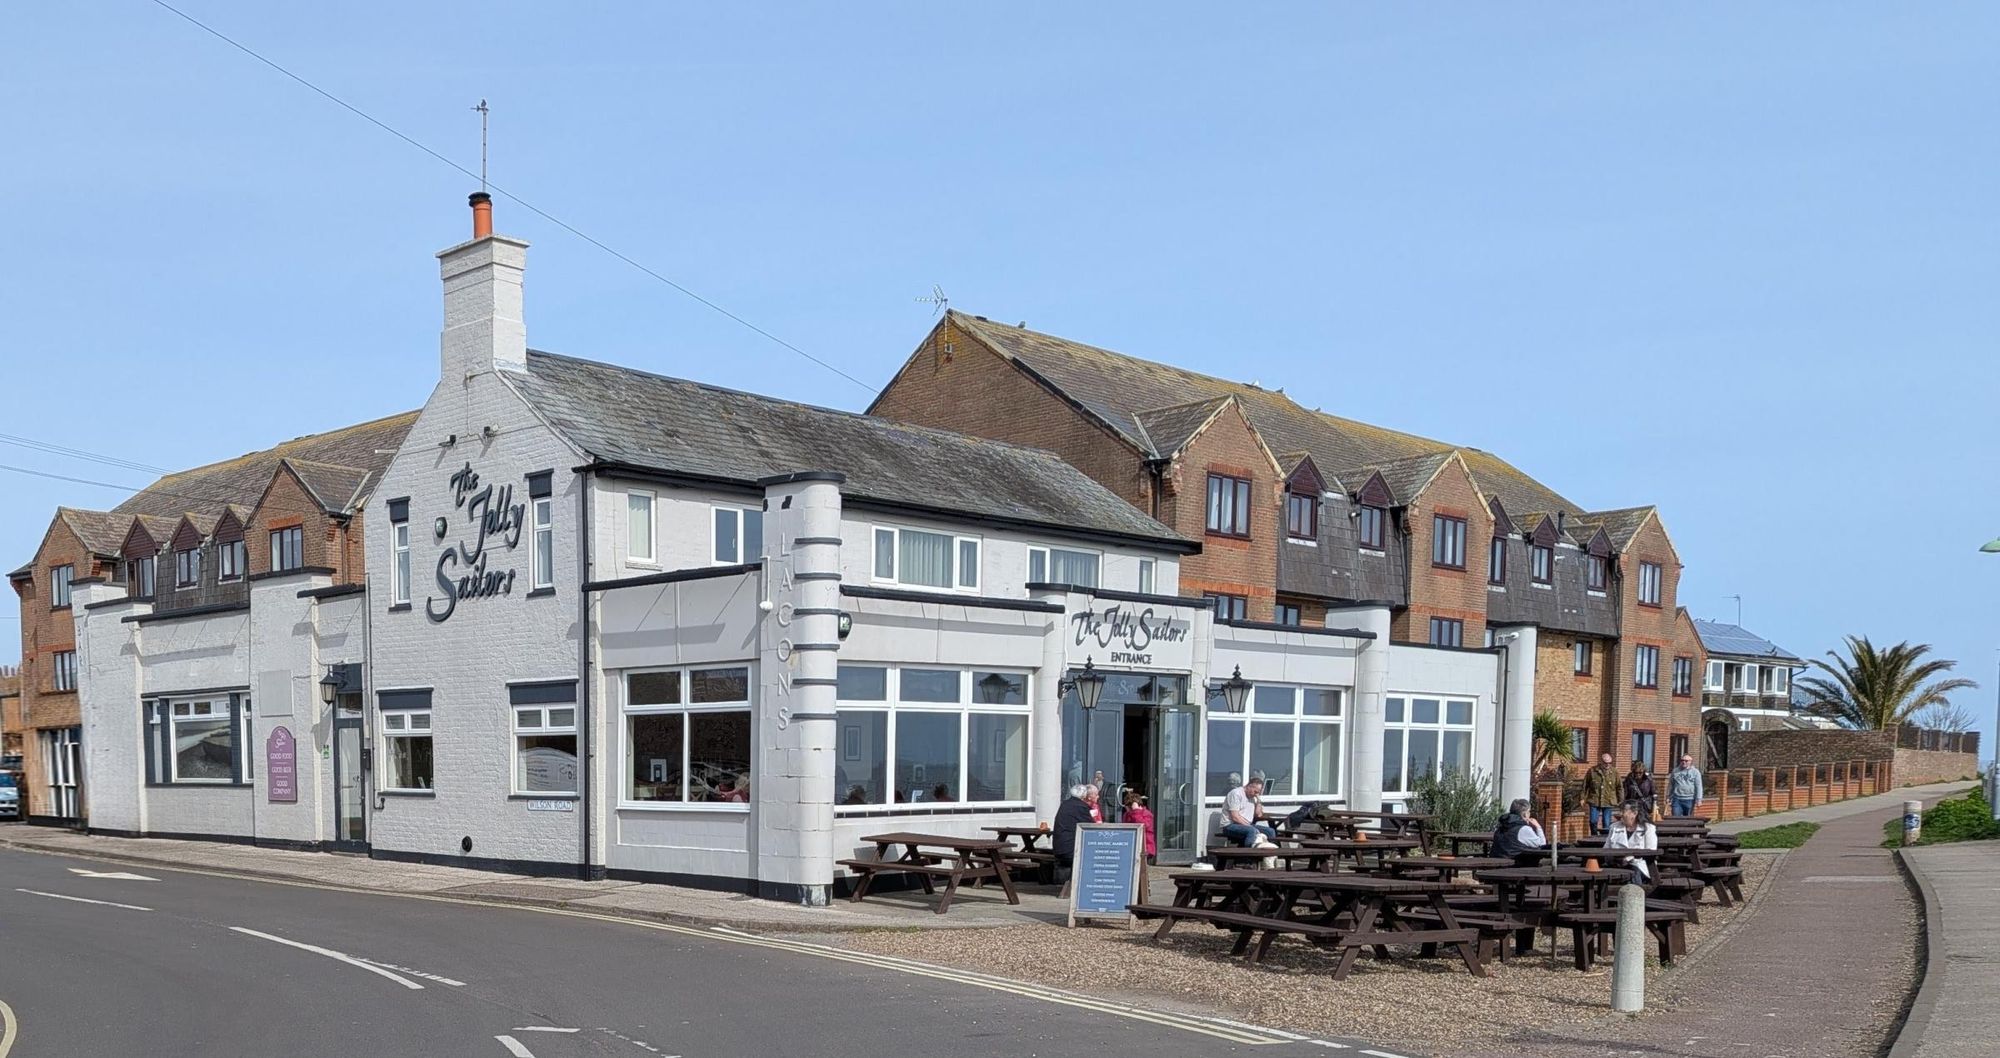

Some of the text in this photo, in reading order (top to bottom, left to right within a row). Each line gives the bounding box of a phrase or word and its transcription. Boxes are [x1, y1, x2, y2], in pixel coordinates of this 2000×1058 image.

[450, 461, 480, 508] The
[460, 483, 526, 564] Jolly
[426, 547, 516, 622] Sailors
[777, 533, 794, 731] LACONS
[1071, 604, 1187, 651] The Jolly Sailors
[1111, 652, 1152, 665] ENTRANCE
[529, 800, 571, 810] WILSON ROAD
